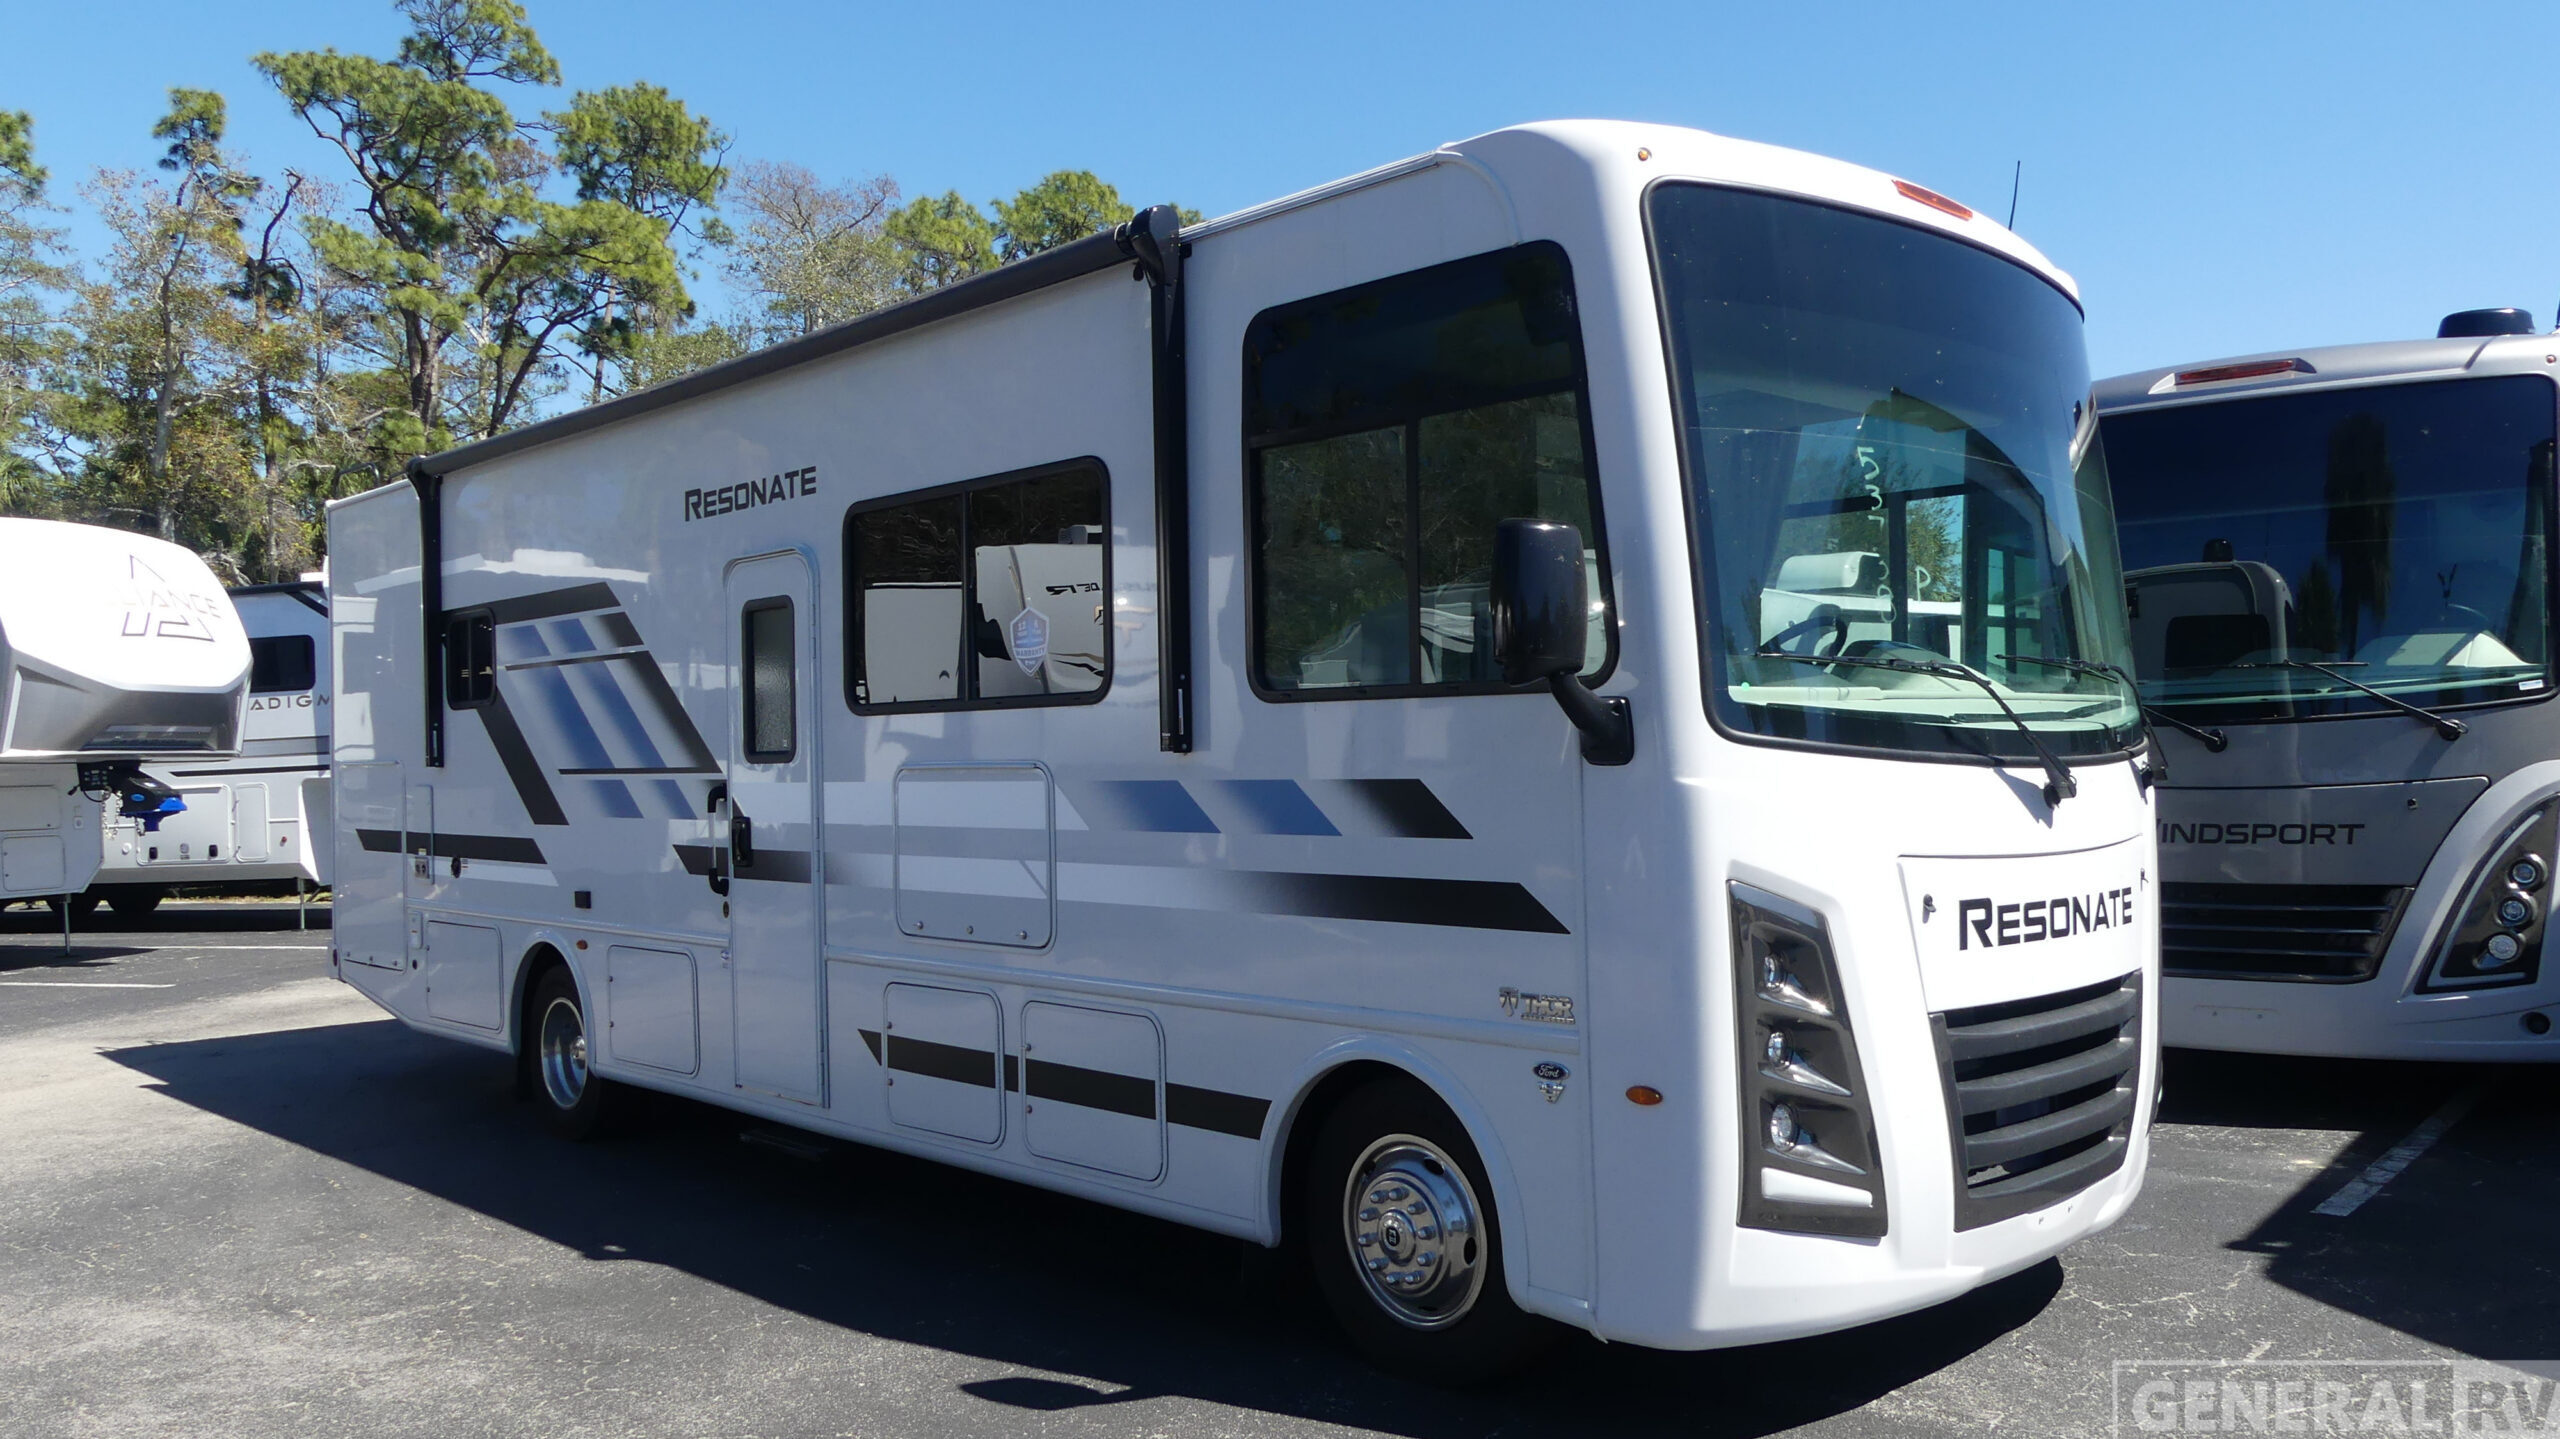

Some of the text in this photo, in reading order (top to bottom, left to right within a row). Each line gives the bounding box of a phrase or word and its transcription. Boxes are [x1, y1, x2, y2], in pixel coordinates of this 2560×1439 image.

[685, 466, 816, 522] RESONATE
[2156, 818, 2365, 845] INDSPORT
[1959, 887, 2132, 951] RESONATE
[1520, 993, 1574, 1018] THOR
[1538, 1065, 1559, 1077] Ford
